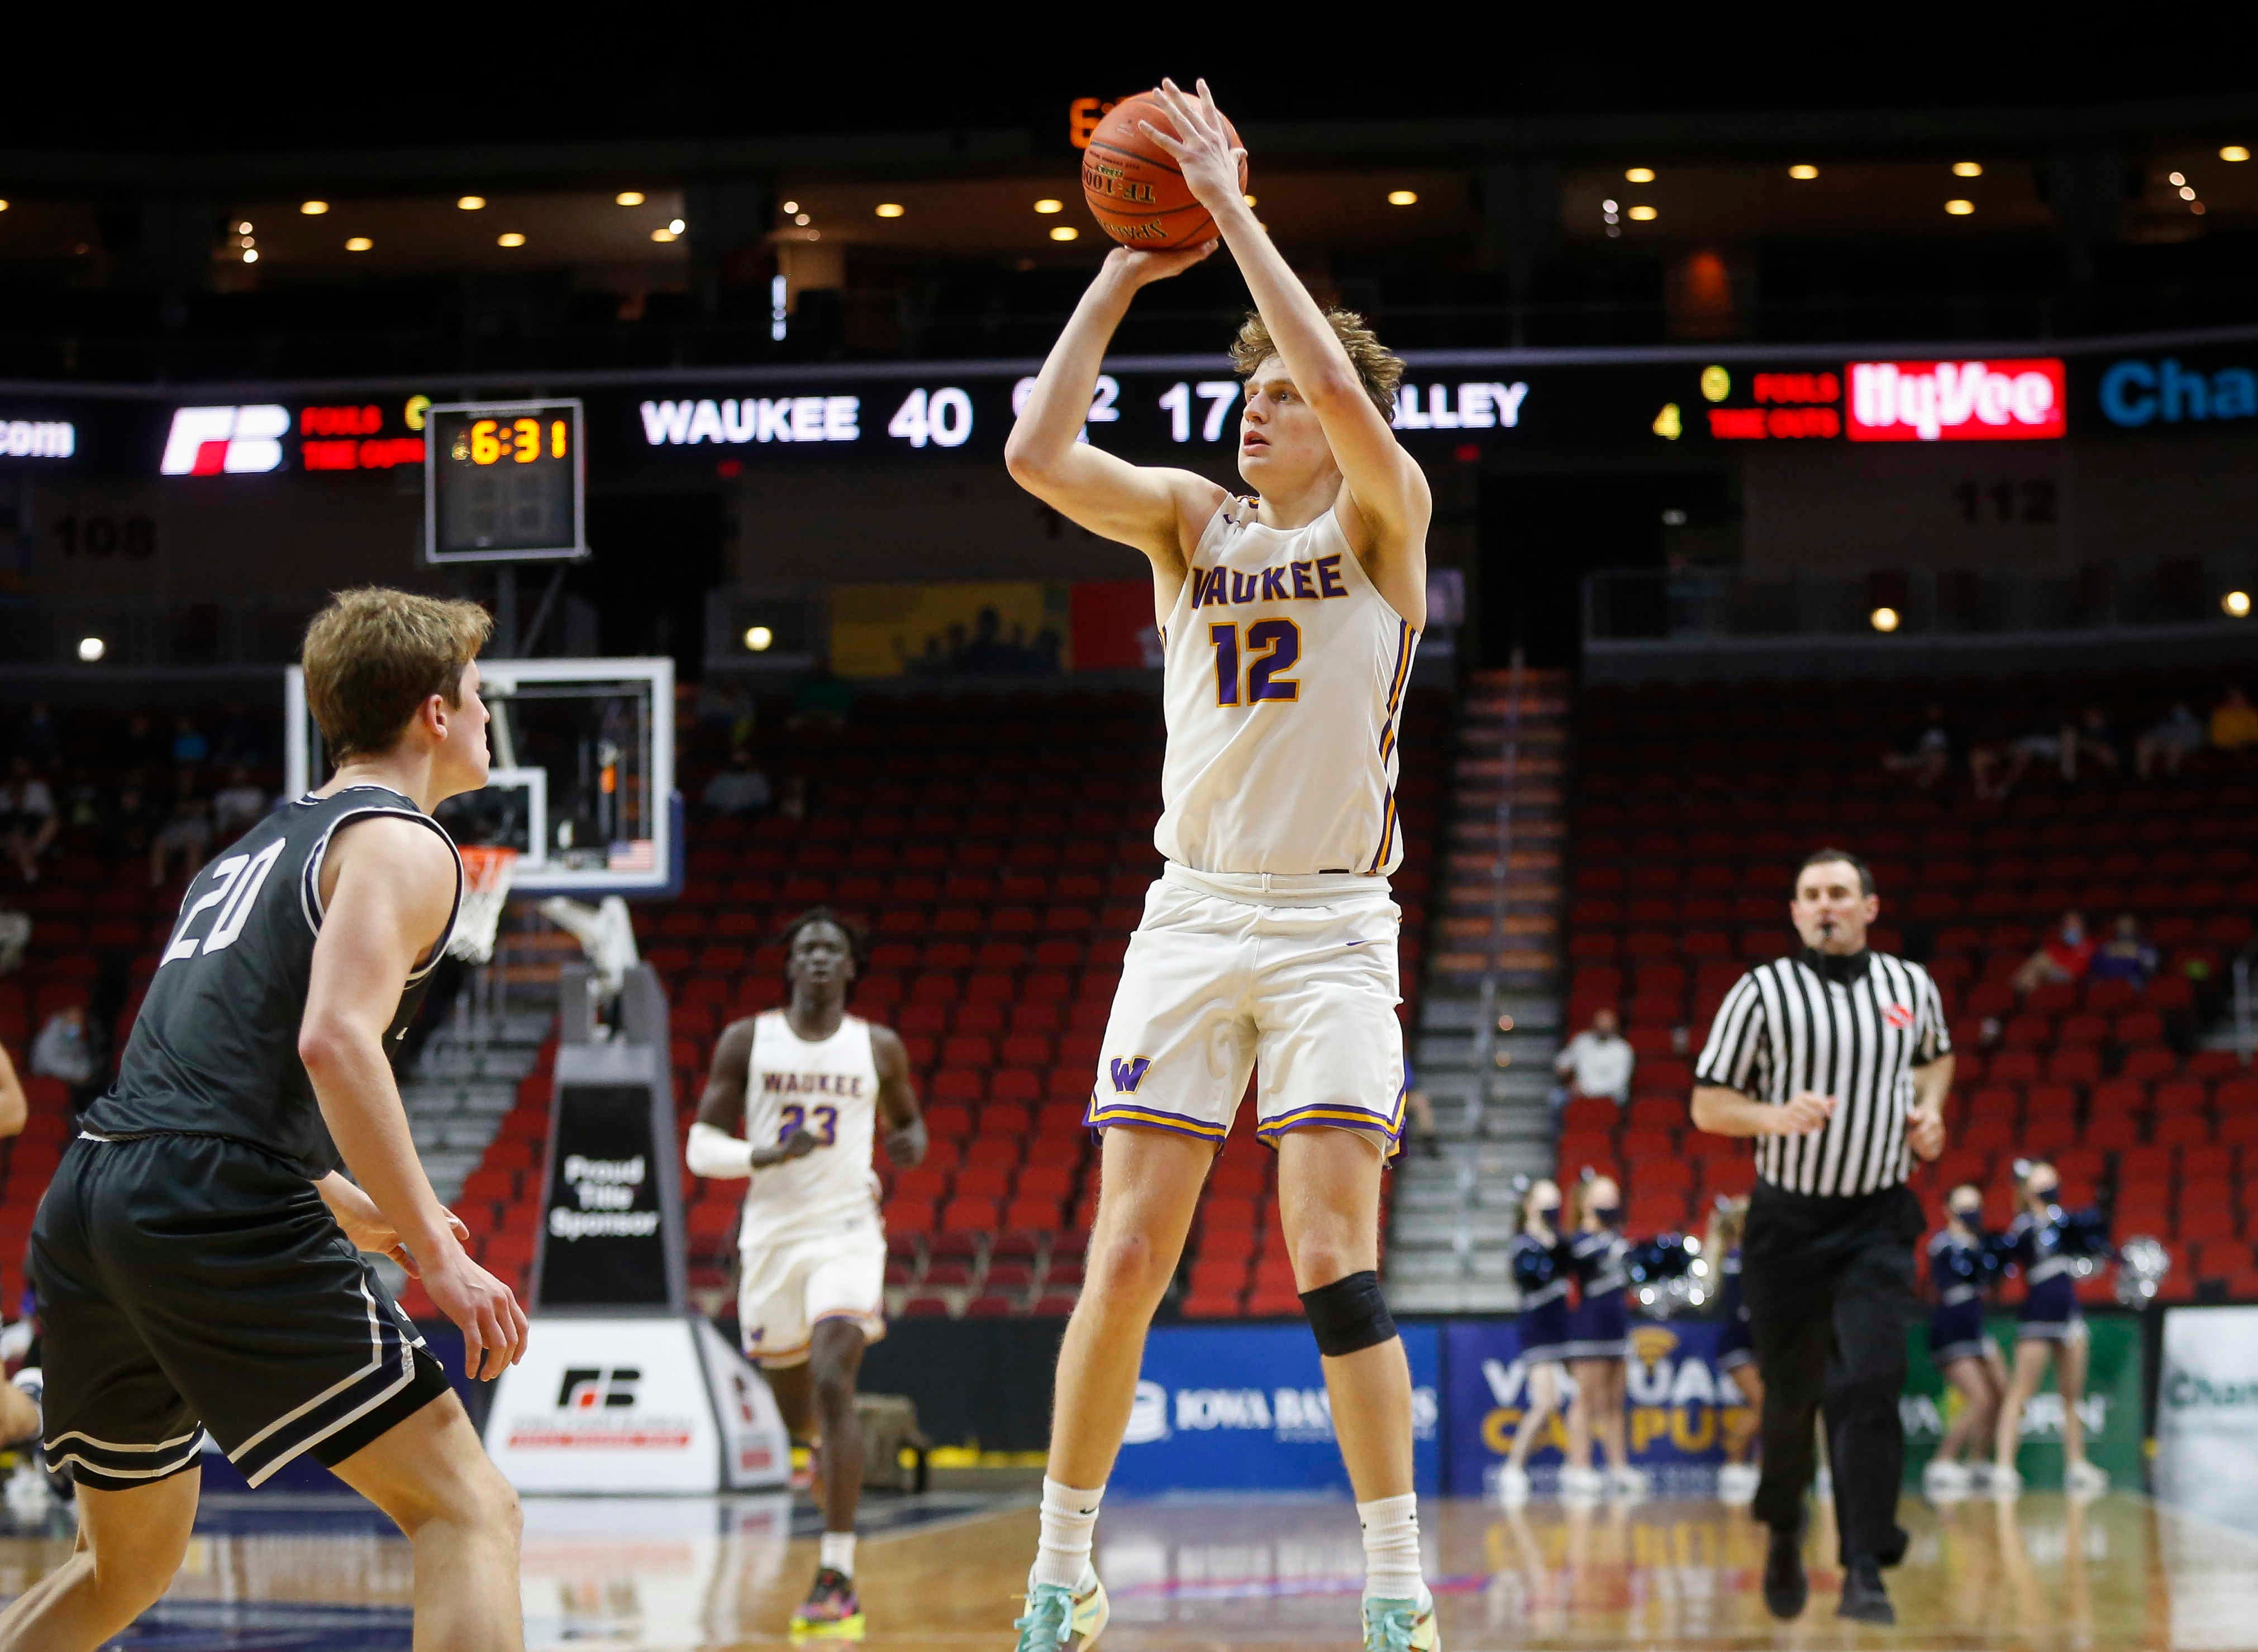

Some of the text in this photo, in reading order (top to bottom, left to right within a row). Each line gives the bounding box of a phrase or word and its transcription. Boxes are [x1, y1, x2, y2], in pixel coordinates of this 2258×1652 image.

[640, 396, 860, 445] WAUKEE
[888, 387, 973, 447] 40
[1159, 381, 1240, 442] 17
[1391, 382, 1529, 429] LLEY
[1652, 402, 1683, 440] 4
[470, 417, 568, 465] 6:31
[1208, 617, 1302, 708] 12
[159, 837, 286, 967] 20
[763, 1072, 863, 1097] WAUKEE
[778, 1103, 839, 1148] 23
[550, 1205, 660, 1243] Sponsor
